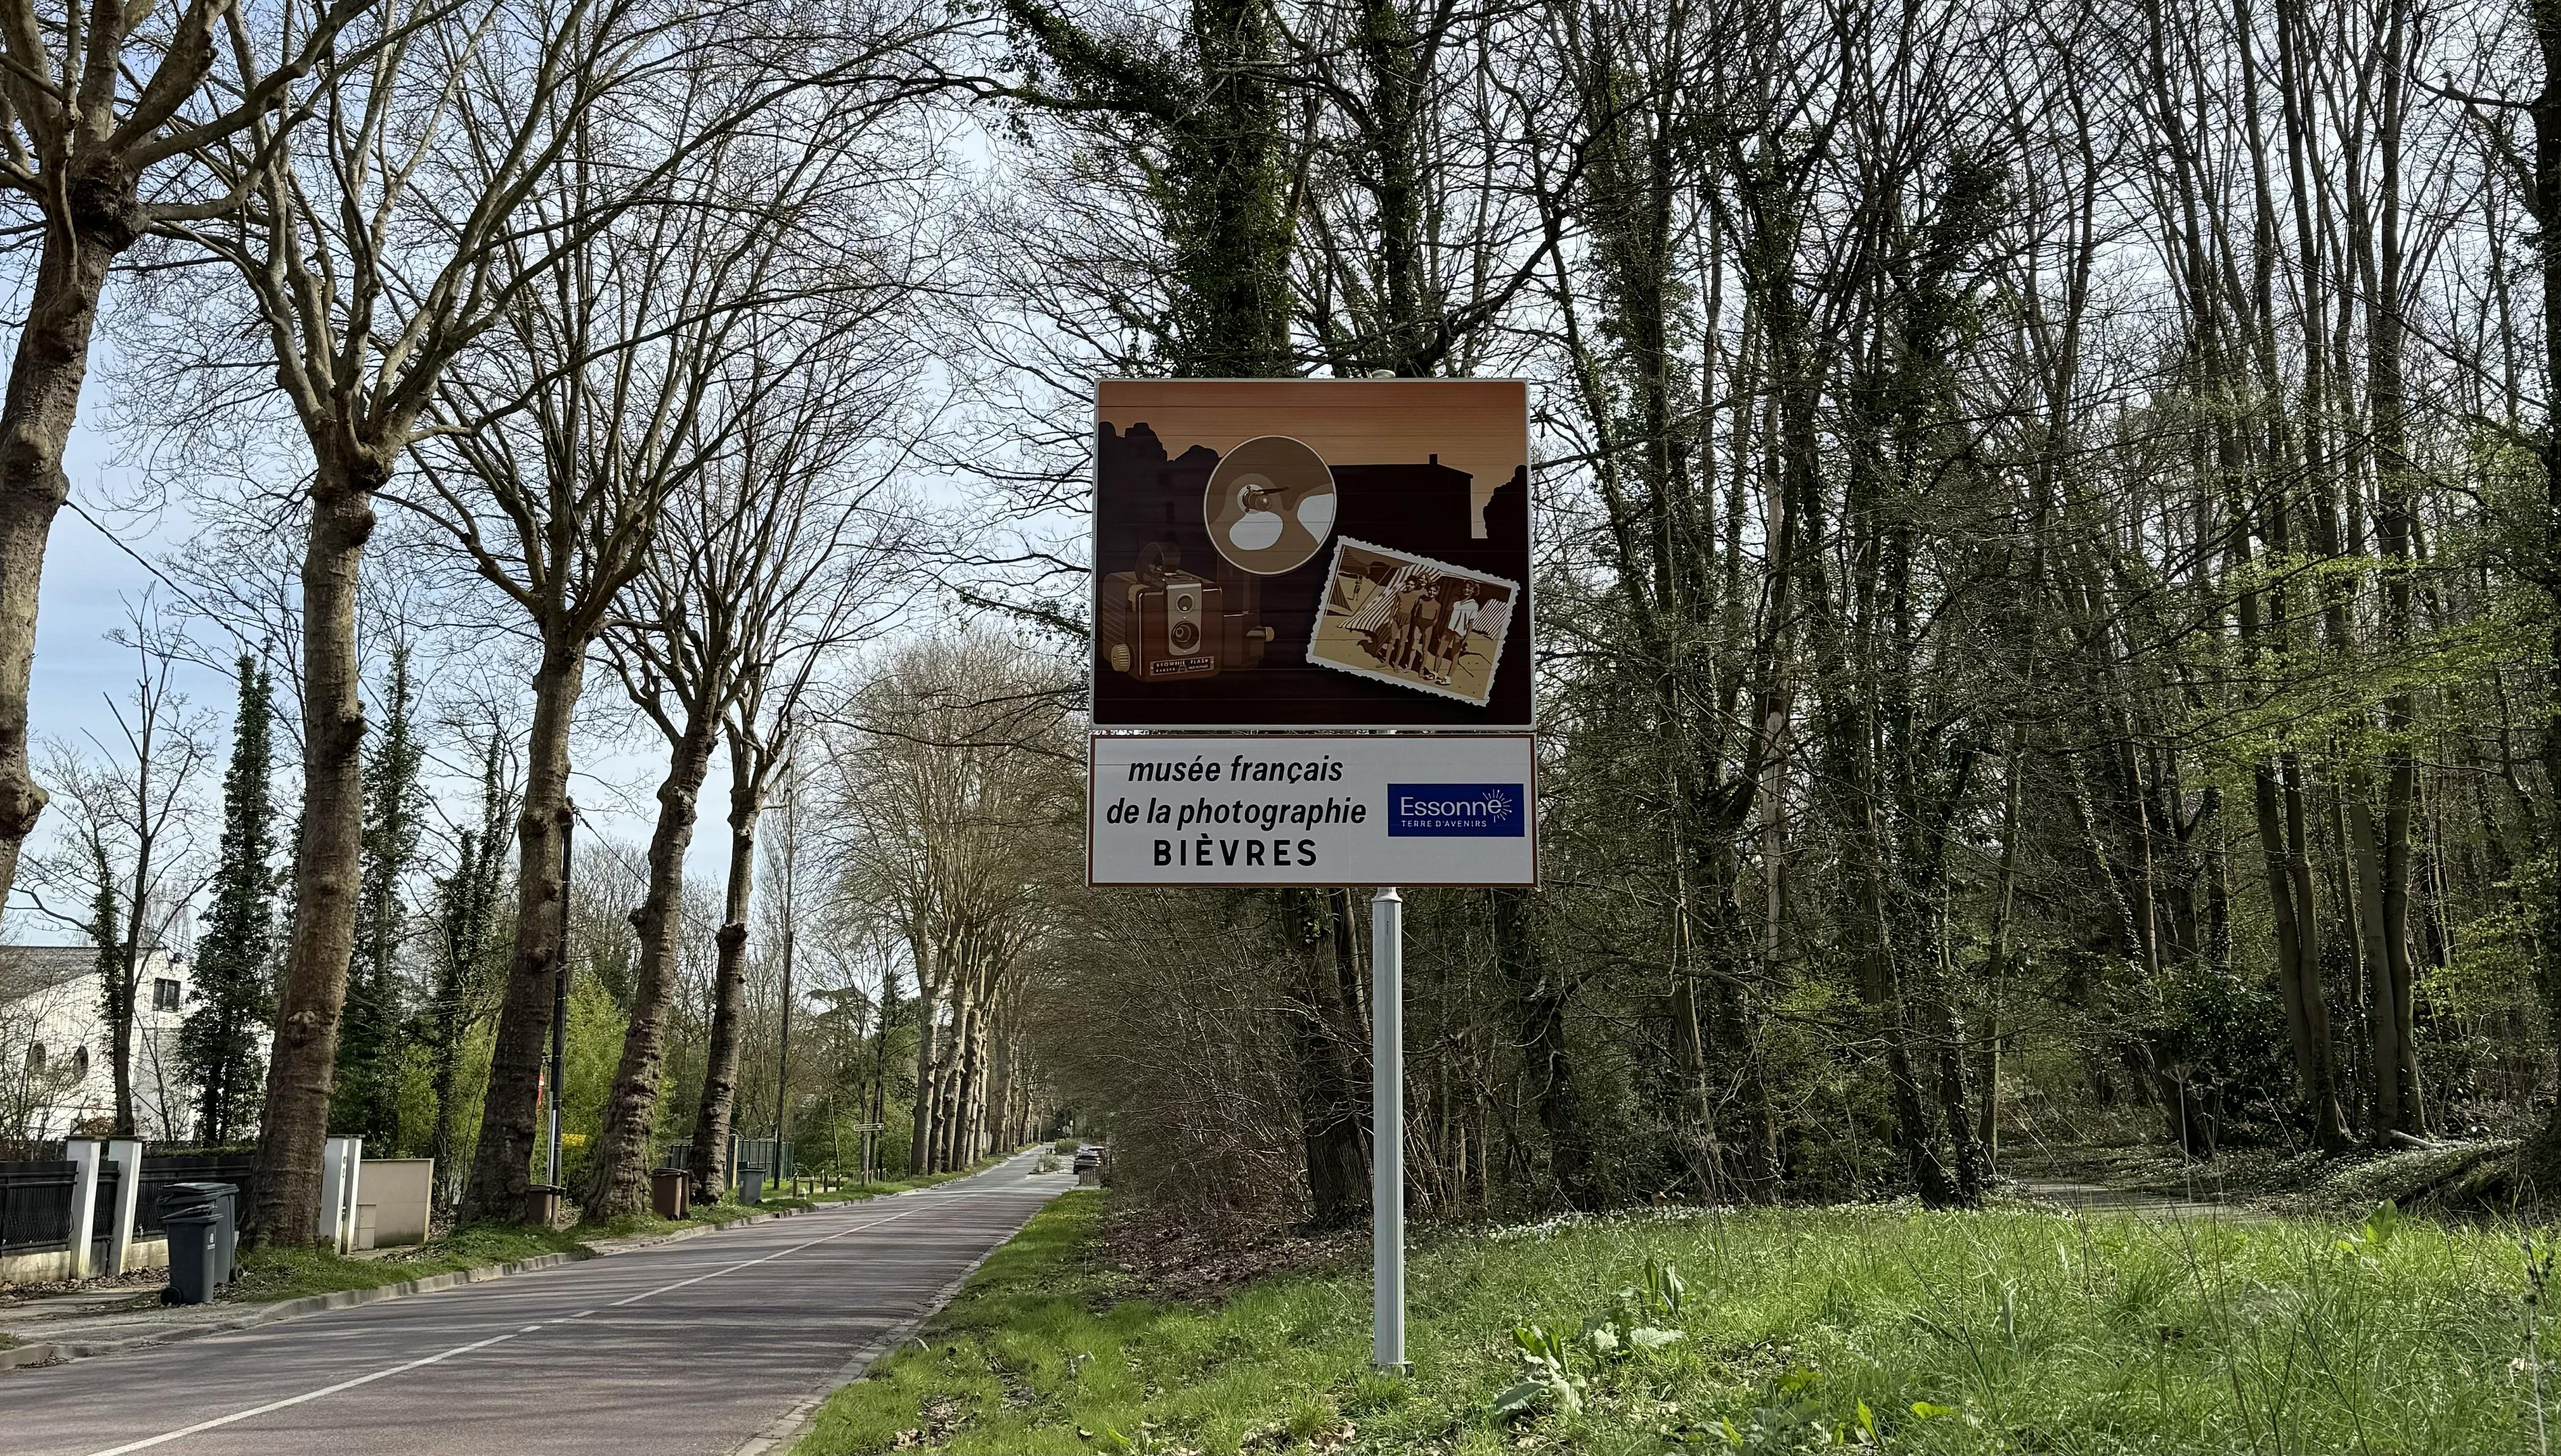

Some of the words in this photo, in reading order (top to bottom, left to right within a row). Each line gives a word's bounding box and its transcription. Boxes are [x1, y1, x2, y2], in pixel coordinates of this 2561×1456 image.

[1128, 755, 1221, 782] musée
[1230, 755, 1343, 785] français
[1106, 797, 1139, 824] de
[1147, 797, 1170, 824] la
[1177, 797, 1366, 832] photographie
[1400, 796, 1502, 816] Essonne
[1154, 833, 1317, 867] BIÈVRES
